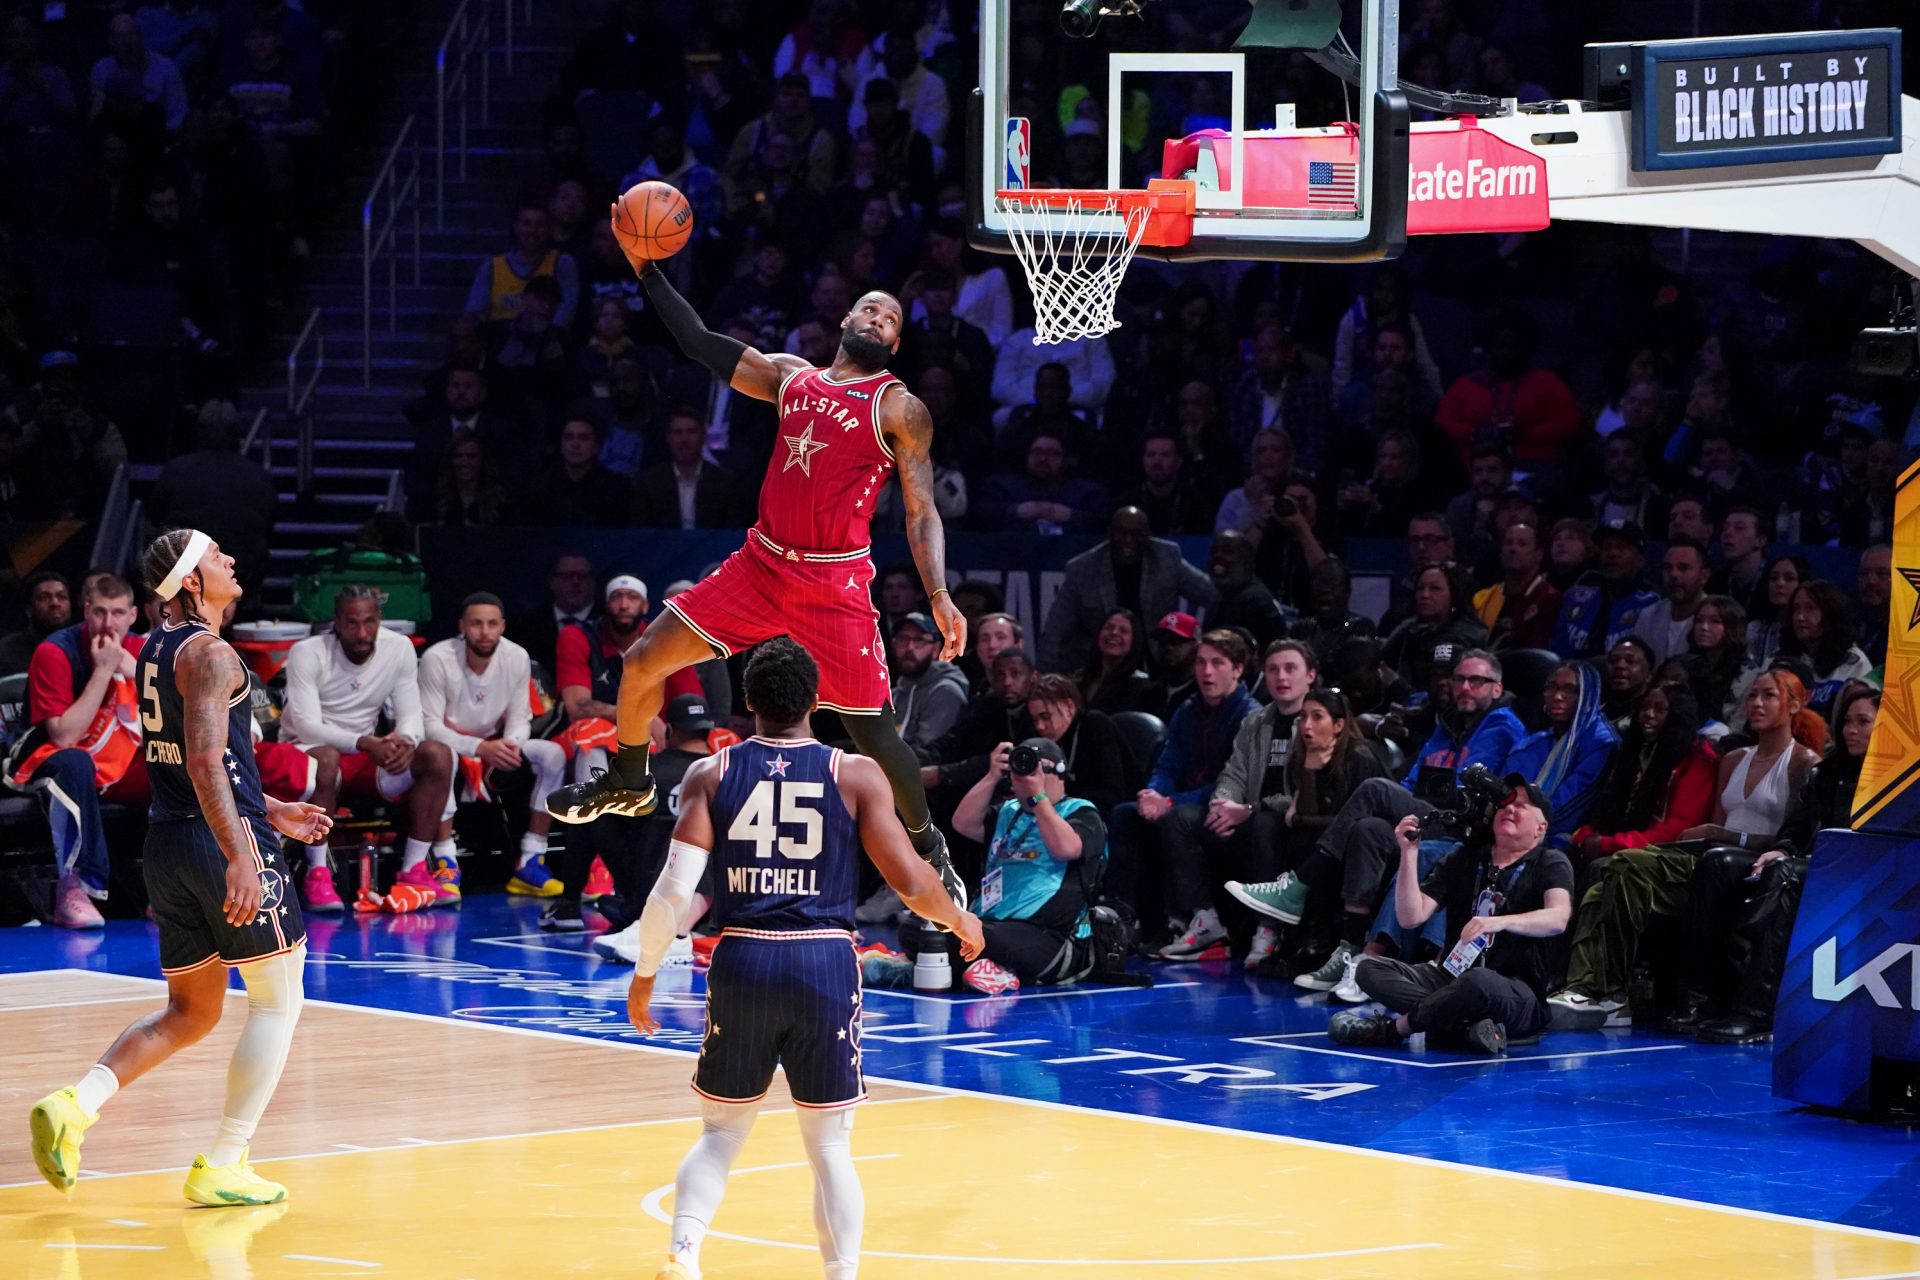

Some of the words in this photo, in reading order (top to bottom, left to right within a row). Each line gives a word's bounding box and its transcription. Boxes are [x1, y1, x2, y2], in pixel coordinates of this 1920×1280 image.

[1675, 62, 1793, 87] BUILT
[1826, 56, 1869, 77] BY
[1675, 87, 1756, 143] BLACK
[1763, 79, 1869, 137] HISTORY
[1408, 161, 1464, 202] tate
[1466, 159, 1537, 199] Farm
[783, 395, 860, 433] ALL-STAR
[142, 661, 164, 733] 5
[727, 780, 825, 860] 45
[727, 866, 821, 896] MITCHELL
[859, 1021, 1379, 1101] ULTRA
